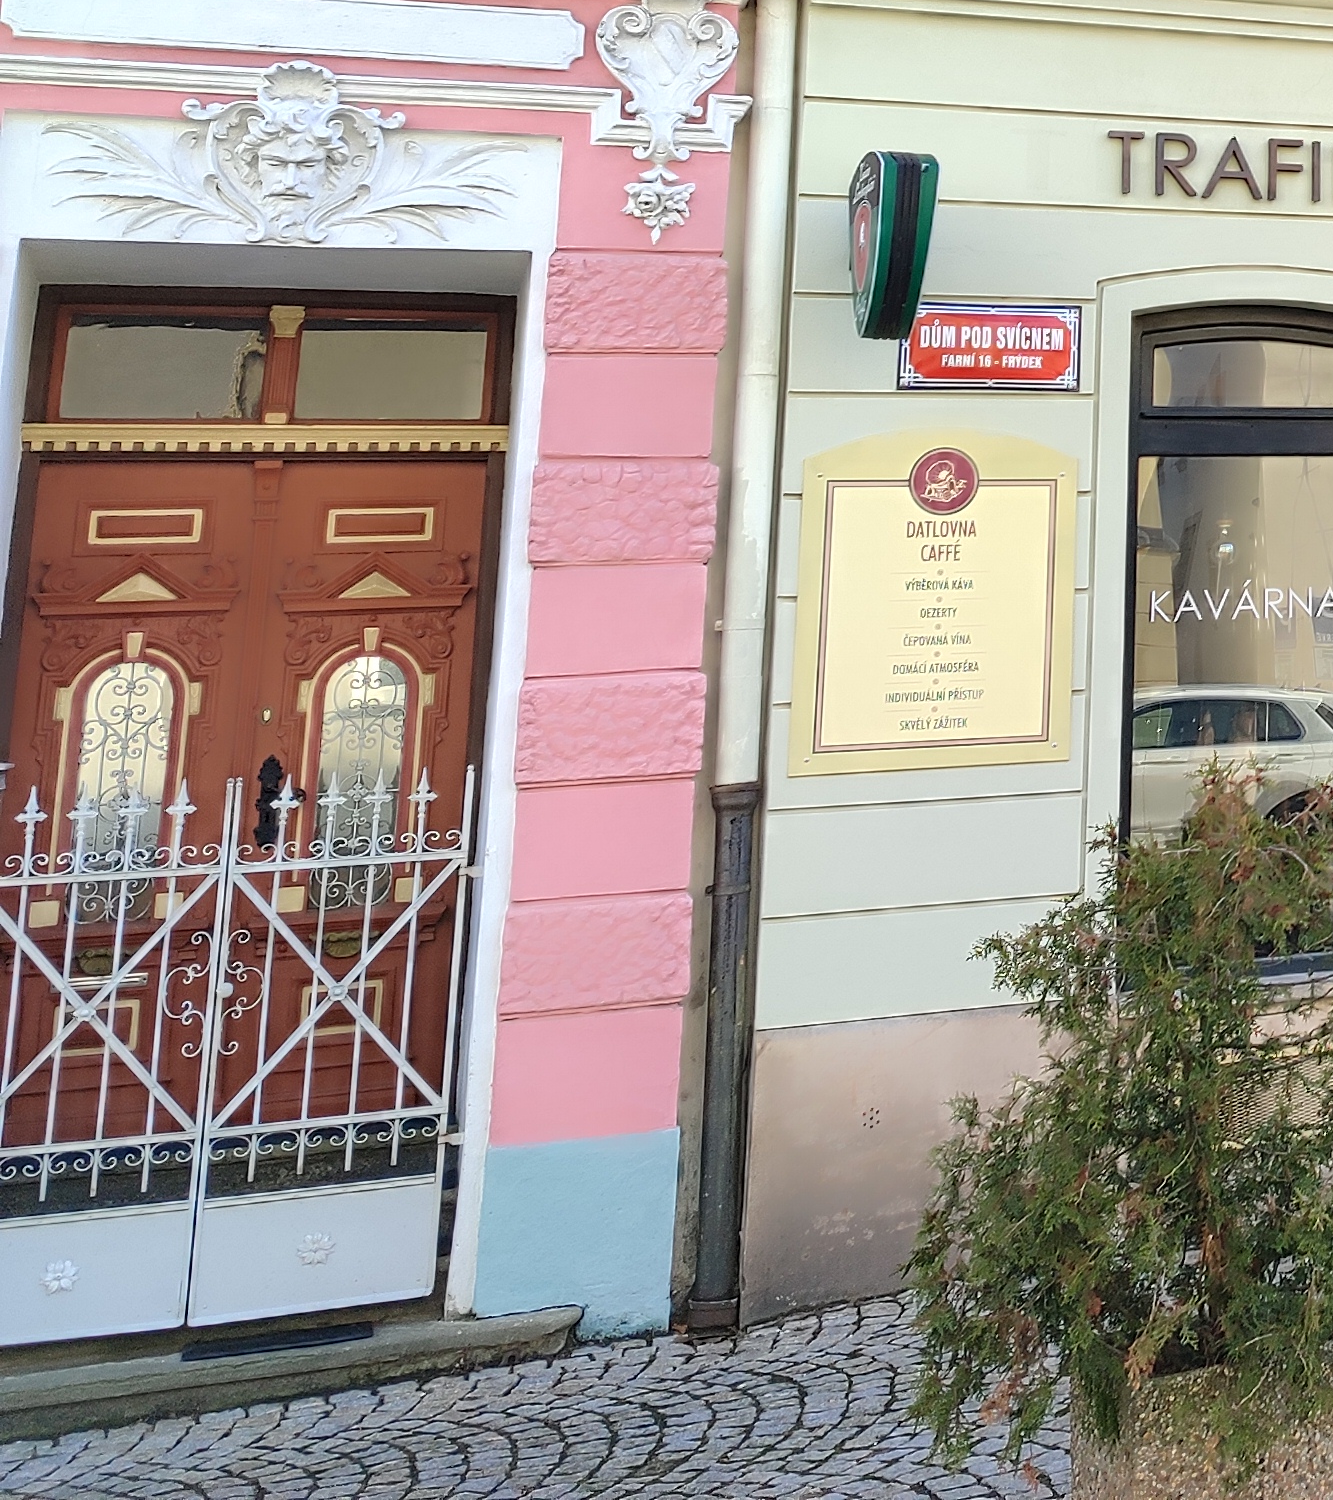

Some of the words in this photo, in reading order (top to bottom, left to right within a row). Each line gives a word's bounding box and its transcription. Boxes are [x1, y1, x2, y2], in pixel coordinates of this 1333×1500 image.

[920, 319, 955, 348] DŮM
[961, 326, 991, 348] POD
[996, 322, 1064, 350] SVÍCNEM
[941, 353, 975, 367] FARNÍ
[978, 354, 991, 367] 16
[1002, 353, 1043, 368] FRÝDEK
[906, 520, 976, 538] DATLOVNA
[921, 539, 961, 561] CAFFÉ
[951, 577, 974, 590] KÁVA
[920, 607, 957, 618] DEZERTY
[903, 632, 948, 646] ČEPOVANÁ
[951, 632, 971, 645] VÍNA
[893, 661, 926, 674] DOMÁCÍ
[929, 659, 979, 673] ATMOSFÉRA
[885, 688, 945, 703] INDIVIDUÁLNÍ
[948, 686, 984, 700] PŘÍSTUP
[899, 717, 931, 730] SKVĚLÝ
[933, 715, 968, 729] ZÁŽITEK
